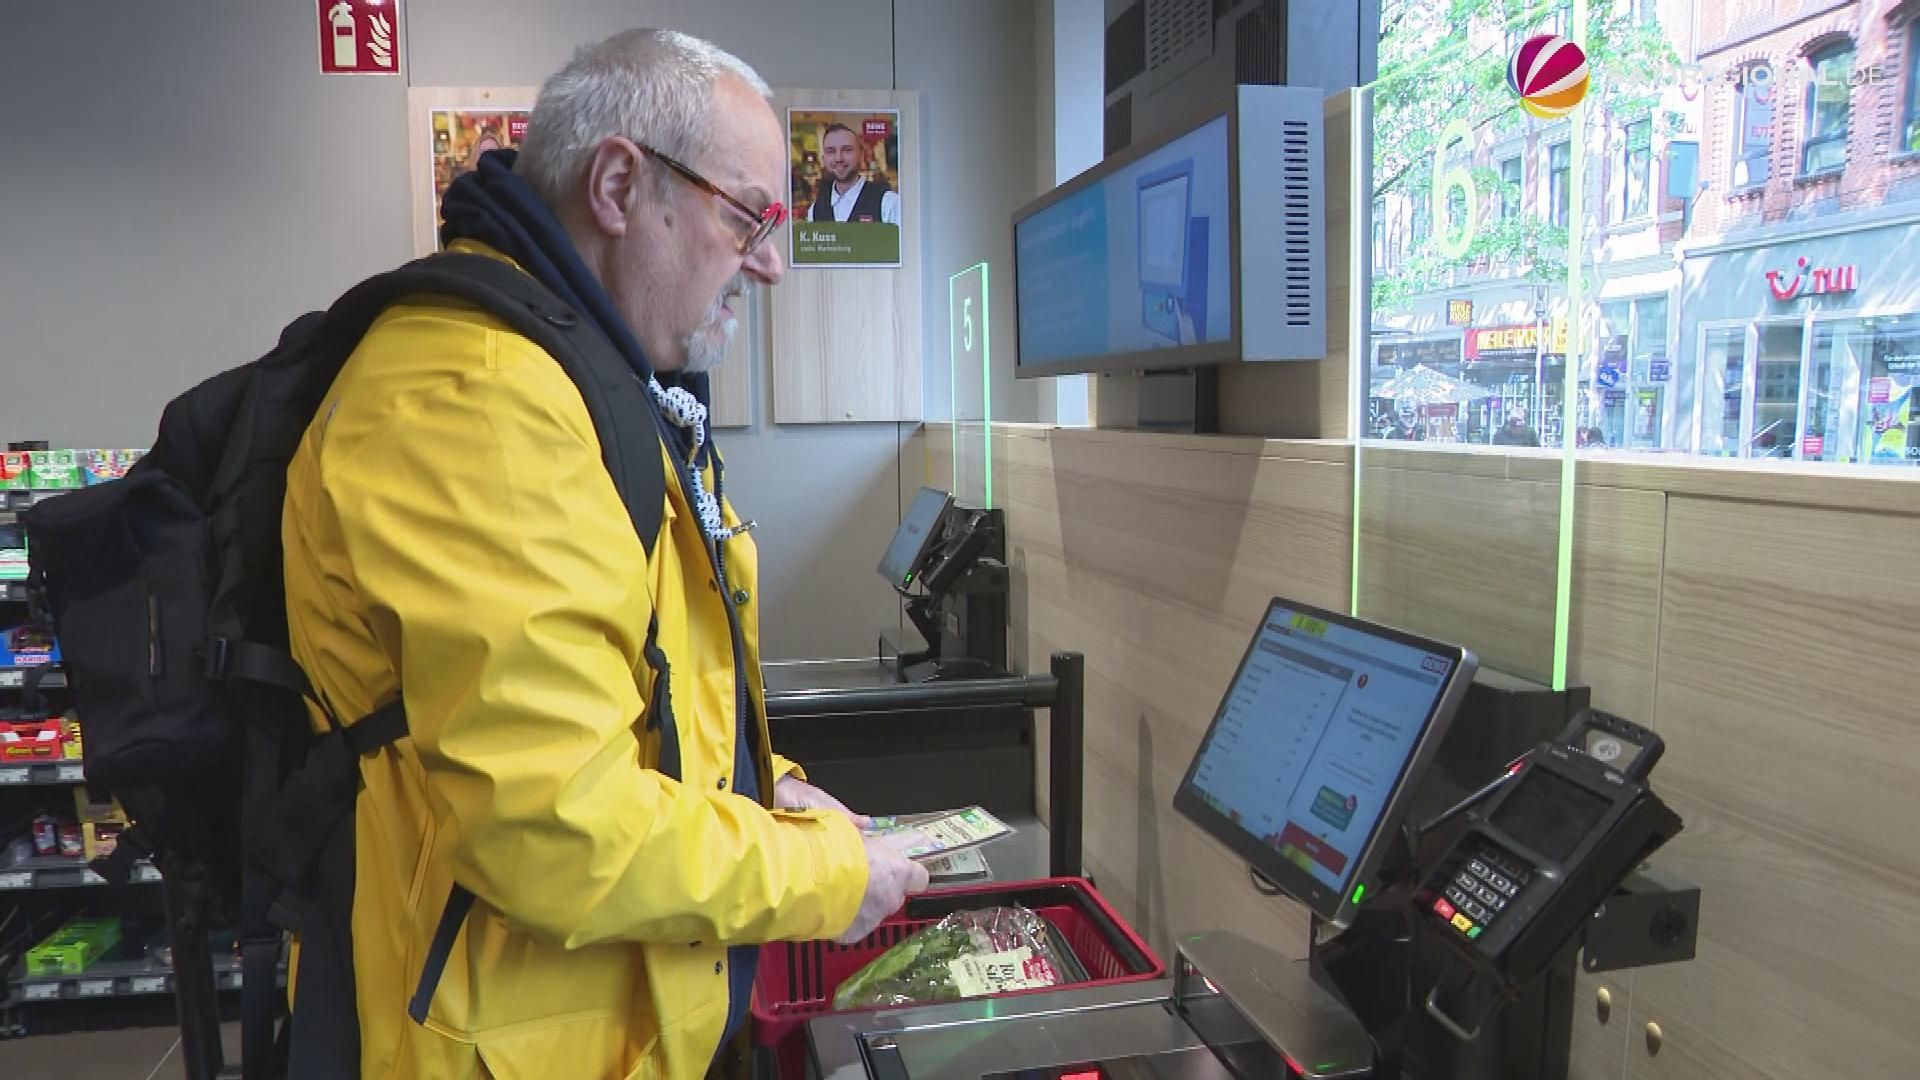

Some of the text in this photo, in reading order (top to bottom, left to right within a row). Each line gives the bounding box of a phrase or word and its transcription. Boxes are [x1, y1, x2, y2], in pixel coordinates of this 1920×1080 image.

[1432, 117, 1477, 260] 6
[799, 230, 837, 242] K. Kuss
[1812, 264, 1858, 294] TUI
[963, 296, 973, 352] 5
